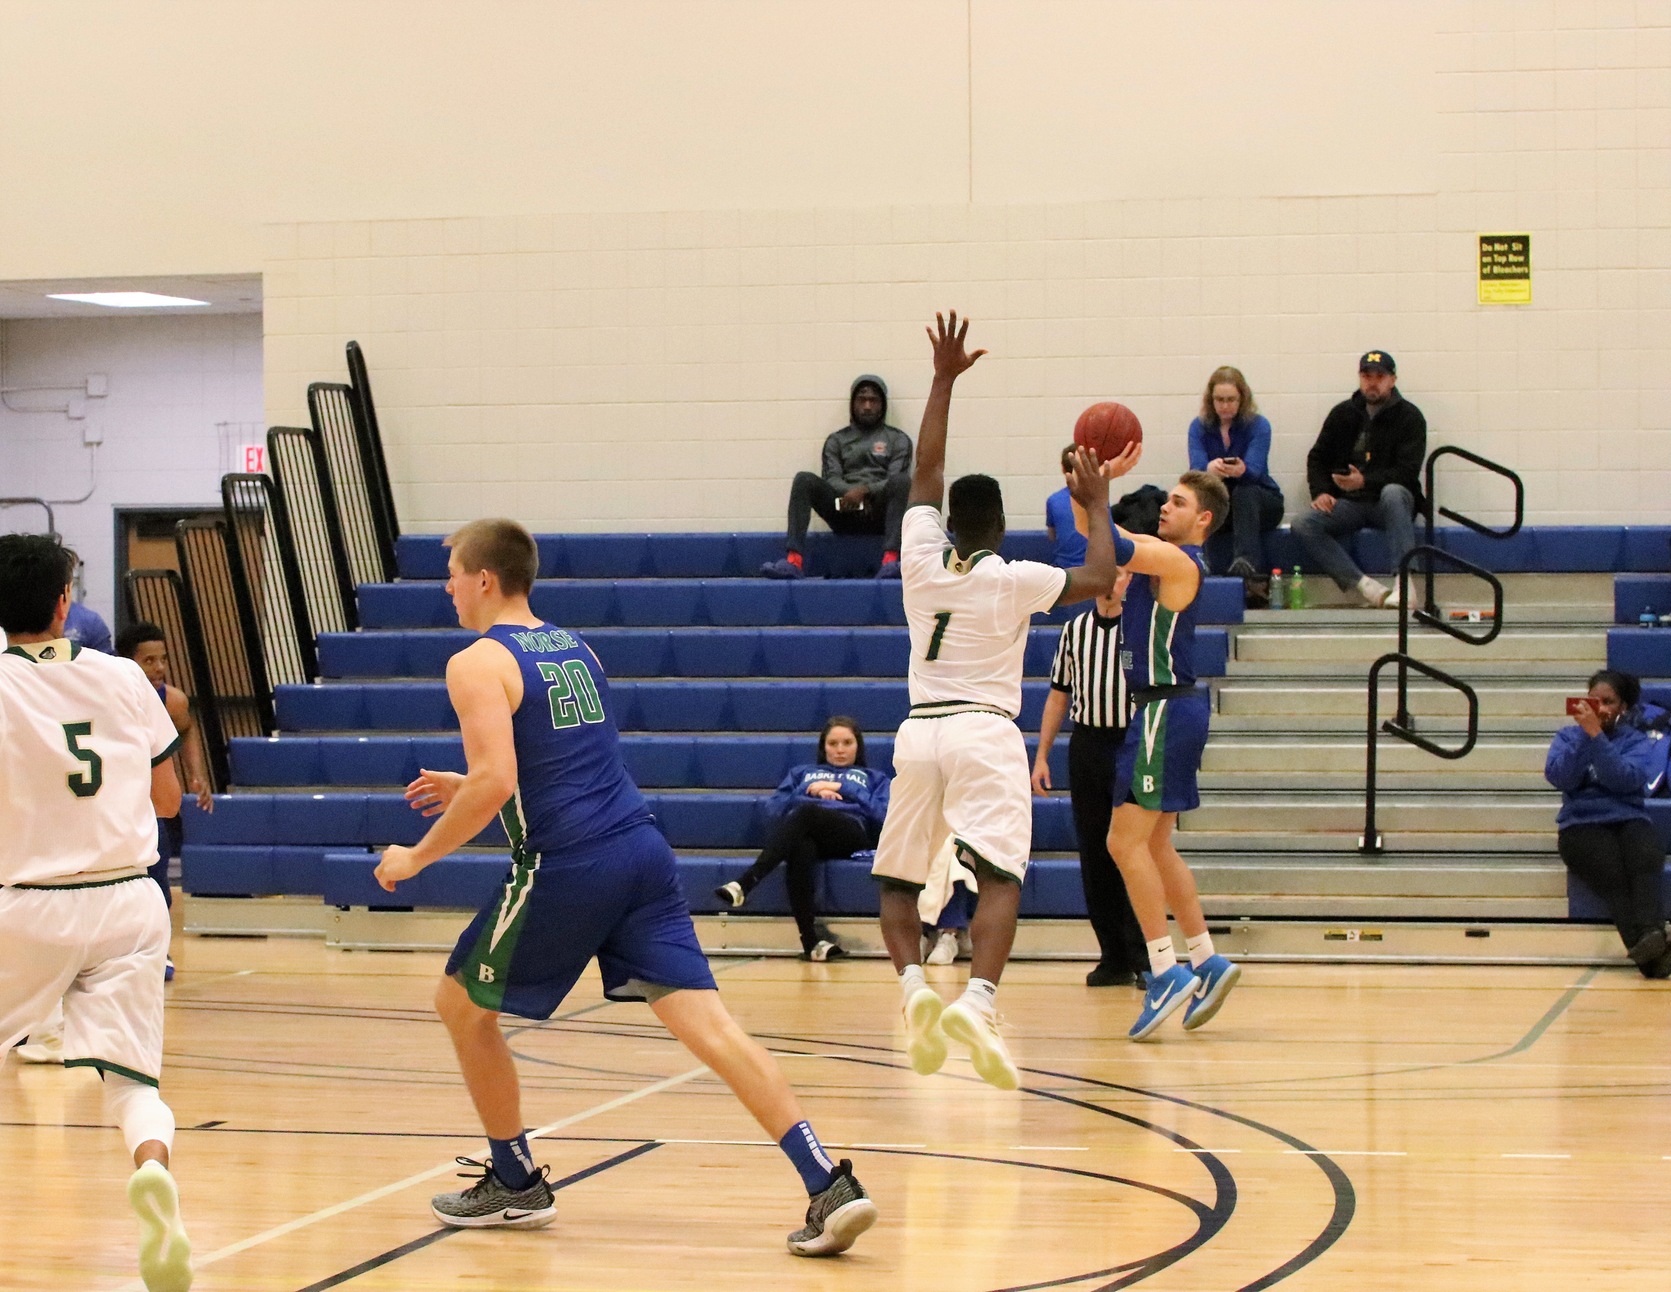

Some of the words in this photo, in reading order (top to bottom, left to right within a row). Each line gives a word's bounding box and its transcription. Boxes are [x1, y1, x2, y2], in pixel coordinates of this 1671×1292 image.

[509, 629, 579, 653] NORSE
[924, 611, 953, 662] 1
[536, 659, 605, 730] 20
[61, 720, 103, 799] 5
[1142, 774, 1155, 793] B
[478, 962, 495, 984] B
